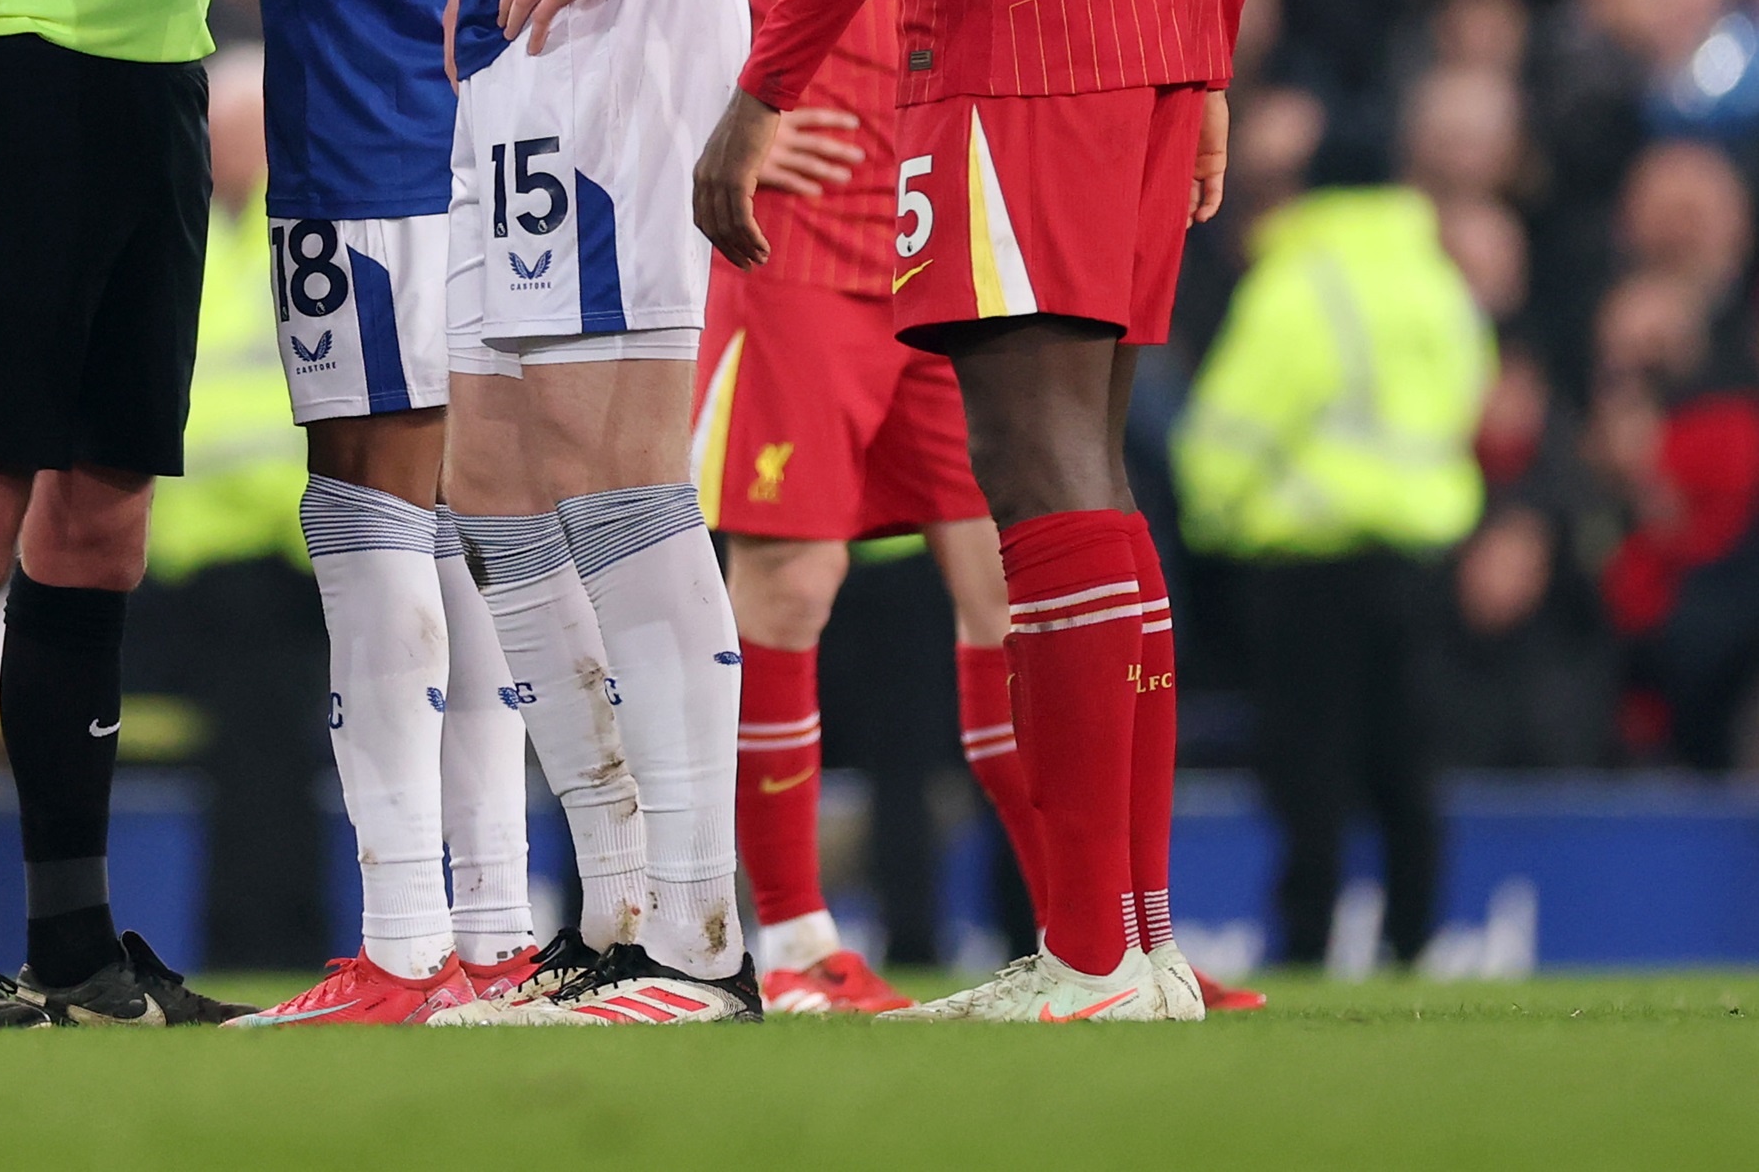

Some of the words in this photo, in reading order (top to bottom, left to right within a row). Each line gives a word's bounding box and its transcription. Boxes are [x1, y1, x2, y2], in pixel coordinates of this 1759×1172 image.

[492, 136, 569, 238] 15
[895, 154, 934, 258] 5
[272, 219, 349, 322] 18
[510, 281, 552, 292] CASTORE
[296, 361, 337, 375] CASTORE
[1136, 672, 1173, 694] LFC
